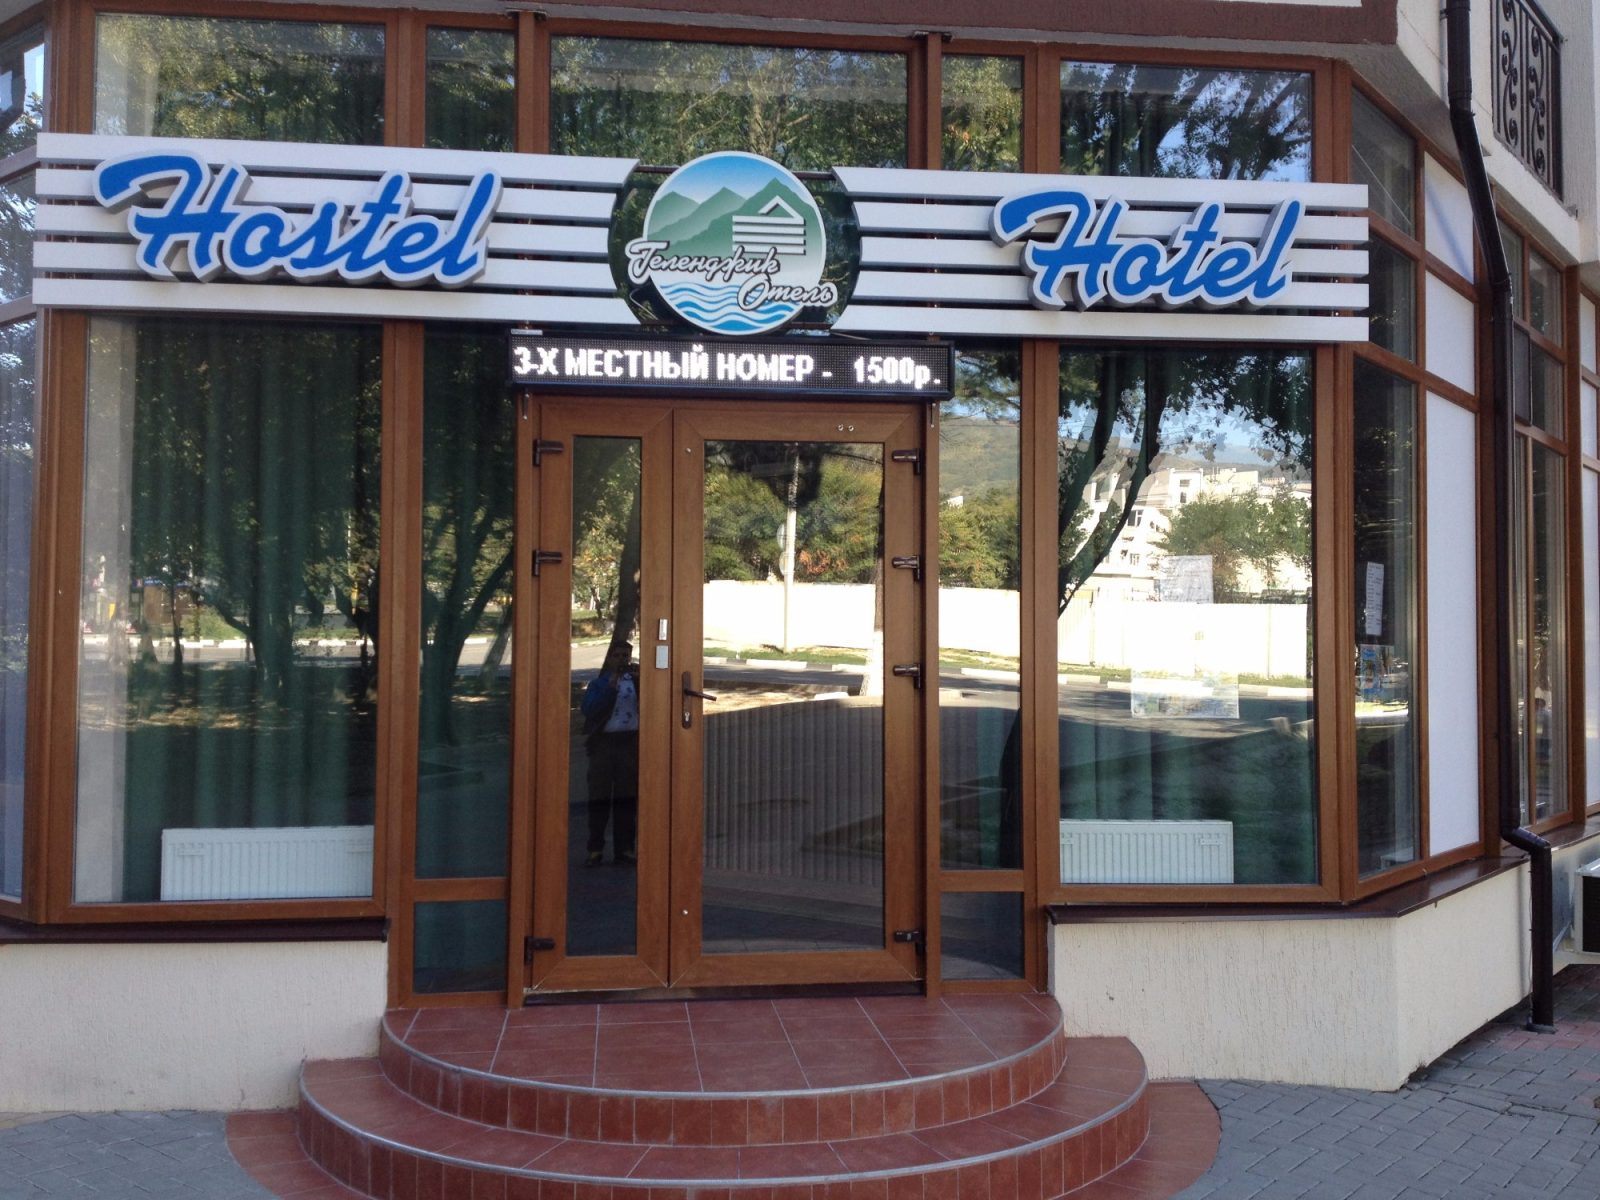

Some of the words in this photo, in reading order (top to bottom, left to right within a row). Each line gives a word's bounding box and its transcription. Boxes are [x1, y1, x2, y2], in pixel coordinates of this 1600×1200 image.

[97, 153, 497, 280] Hostel
[628, 239, 781, 282] Геленджик
[998, 189, 1302, 300] Hotel
[737, 273, 834, 311] Отель
[513, 346, 559, 376] 3-Х
[564, 343, 710, 380] МЕСТНЫЙ
[716, 352, 814, 382] НОМЕР
[853, 355, 941, 390] 1500р.
